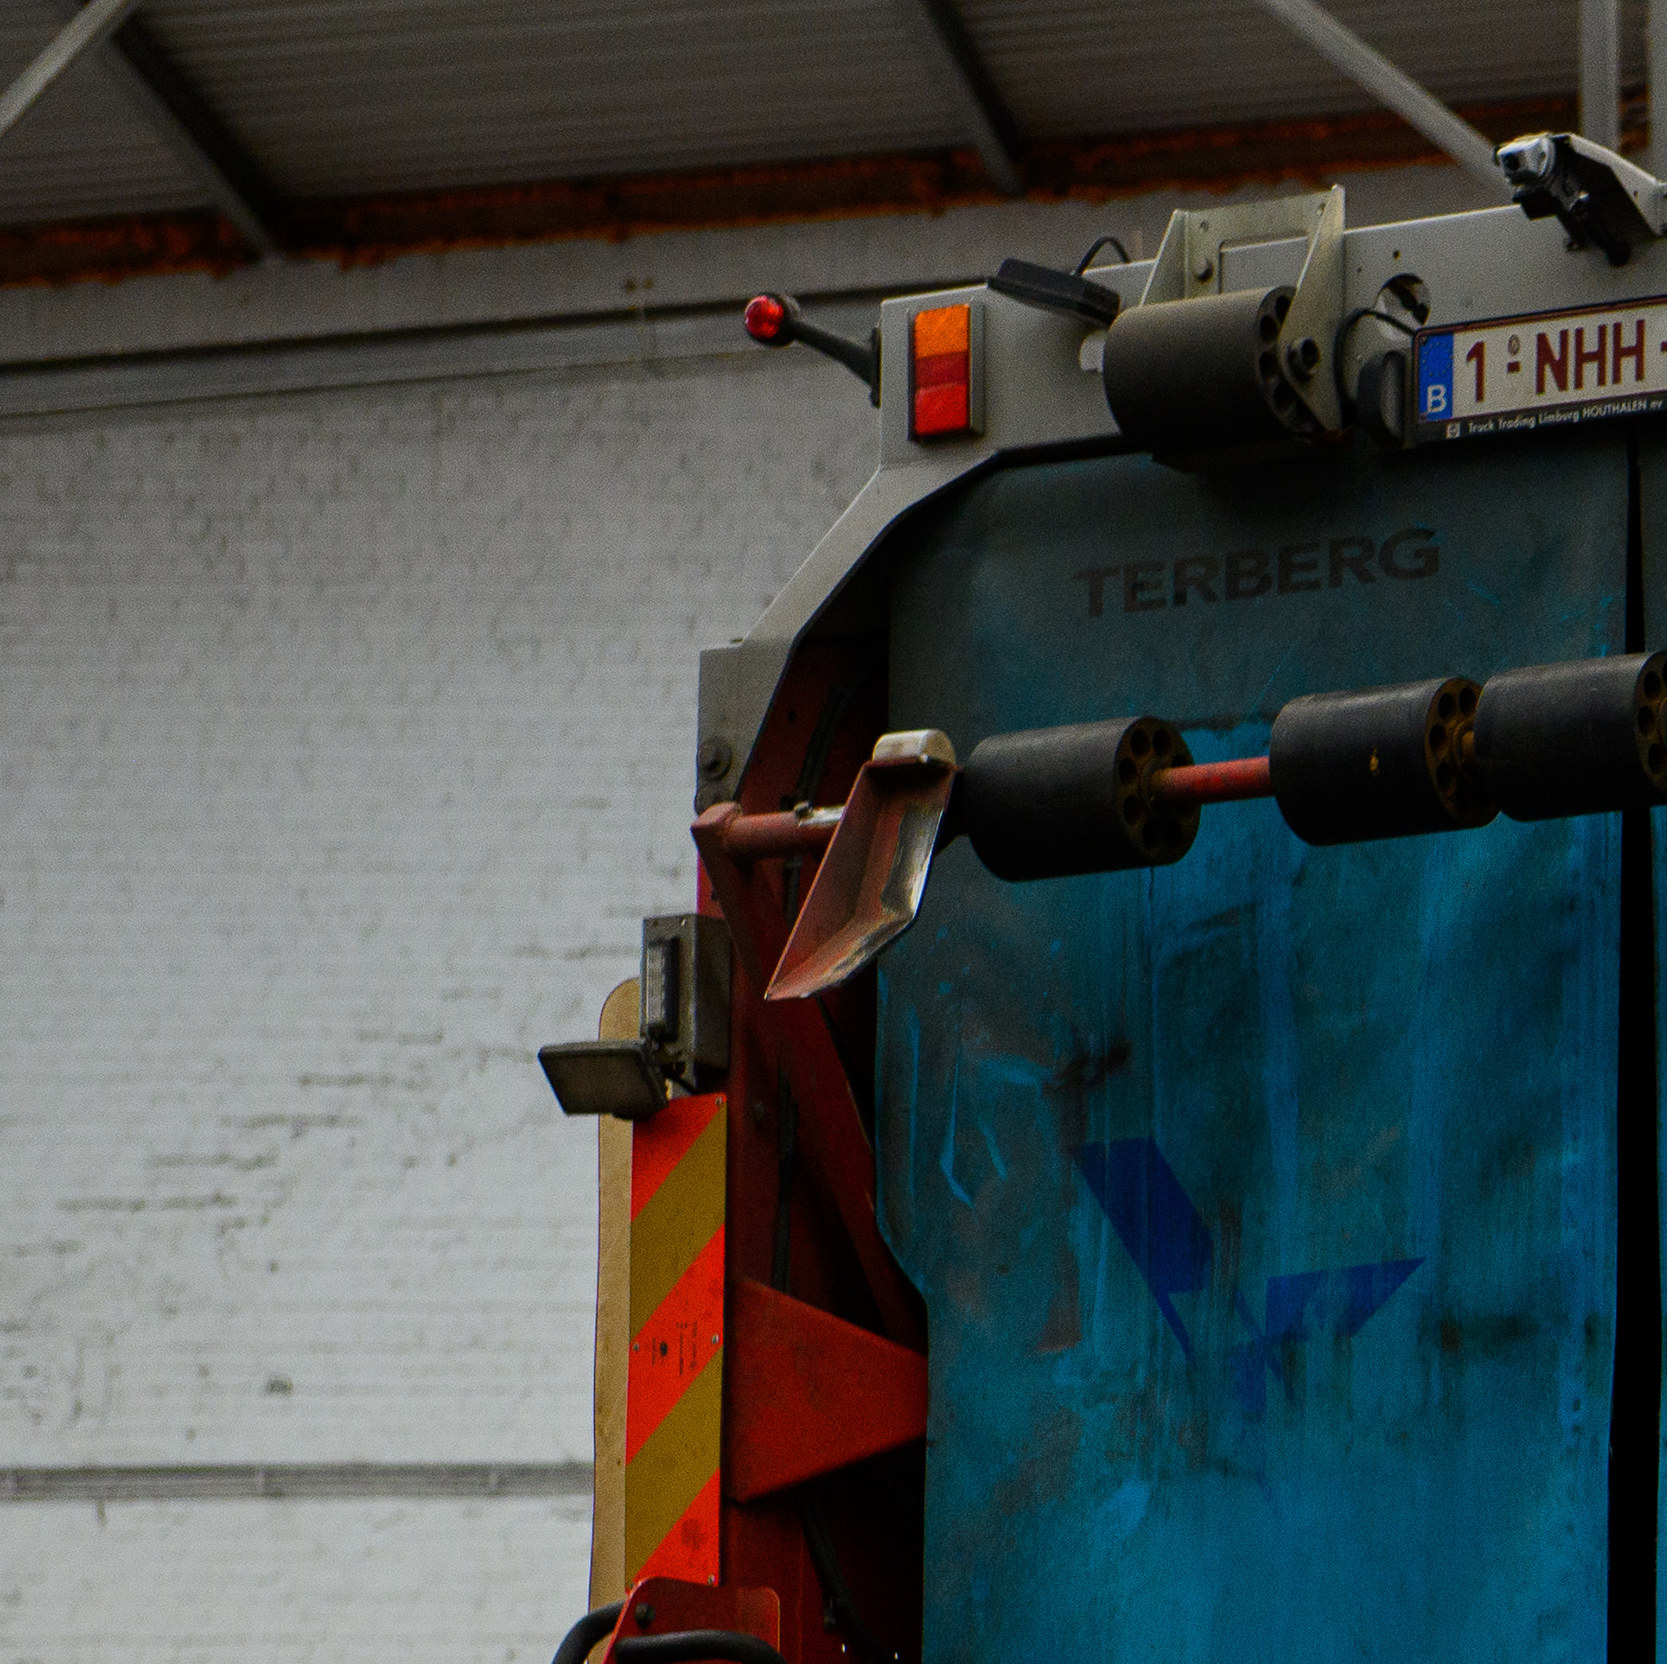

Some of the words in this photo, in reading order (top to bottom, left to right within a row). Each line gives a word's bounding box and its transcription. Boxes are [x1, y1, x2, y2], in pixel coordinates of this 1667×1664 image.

[1427, 385, 1448, 414] B
[1468, 419, 1494, 434] Truck
[1498, 413, 1536, 431] Trading
[1538, 406, 1580, 424] Limburg
[1582, 399, 1647, 420] HOUTHALEN
[1072, 526, 1442, 618] TERBERG
